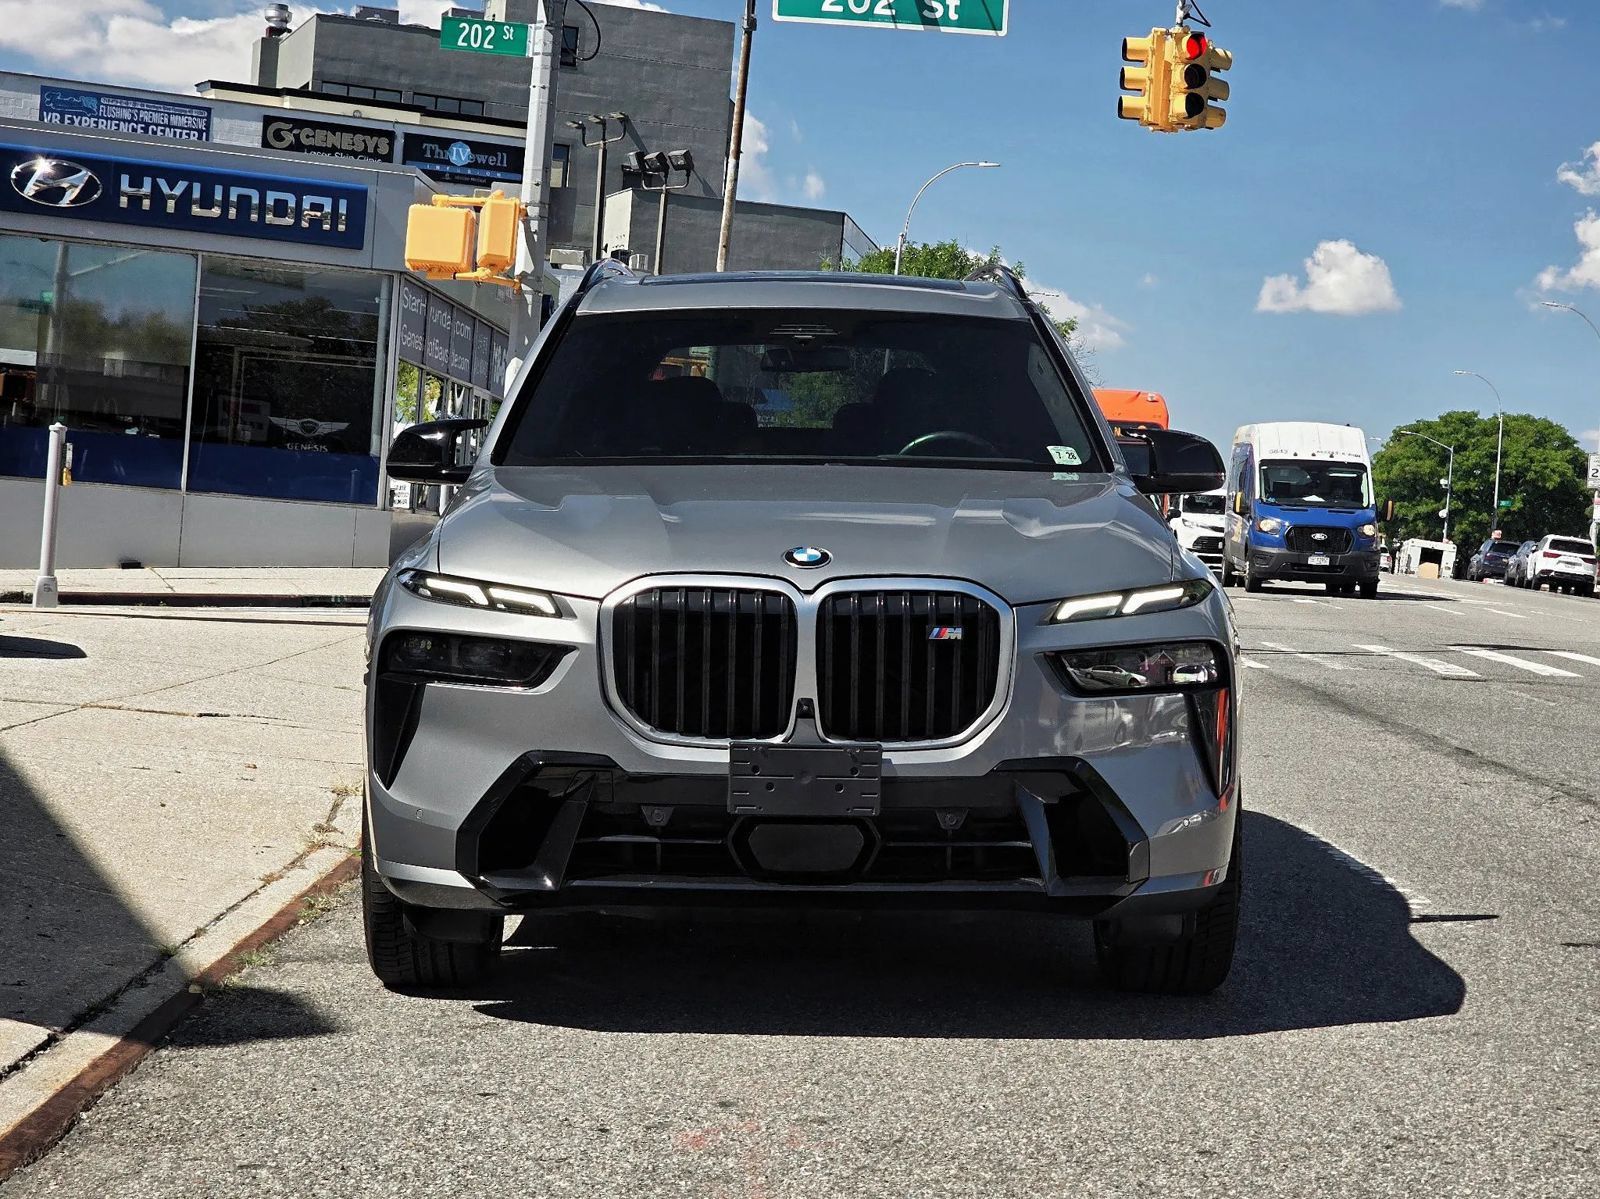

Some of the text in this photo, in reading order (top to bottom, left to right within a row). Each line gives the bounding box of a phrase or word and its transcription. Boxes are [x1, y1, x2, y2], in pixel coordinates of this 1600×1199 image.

[457, 22, 514, 49] 202 St
[43, 111, 61, 124] VR
[64, 114, 146, 135] EXPERIENCE
[99, 105, 138, 121] FLUSHING'S
[139, 110, 169, 125] PREMIER
[170, 114, 208, 130] IMMERSIVE
[299, 127, 390, 155] GENESYS
[119, 173, 348, 233] HYUNDAI
[287, 442, 328, 453] GENESIS
